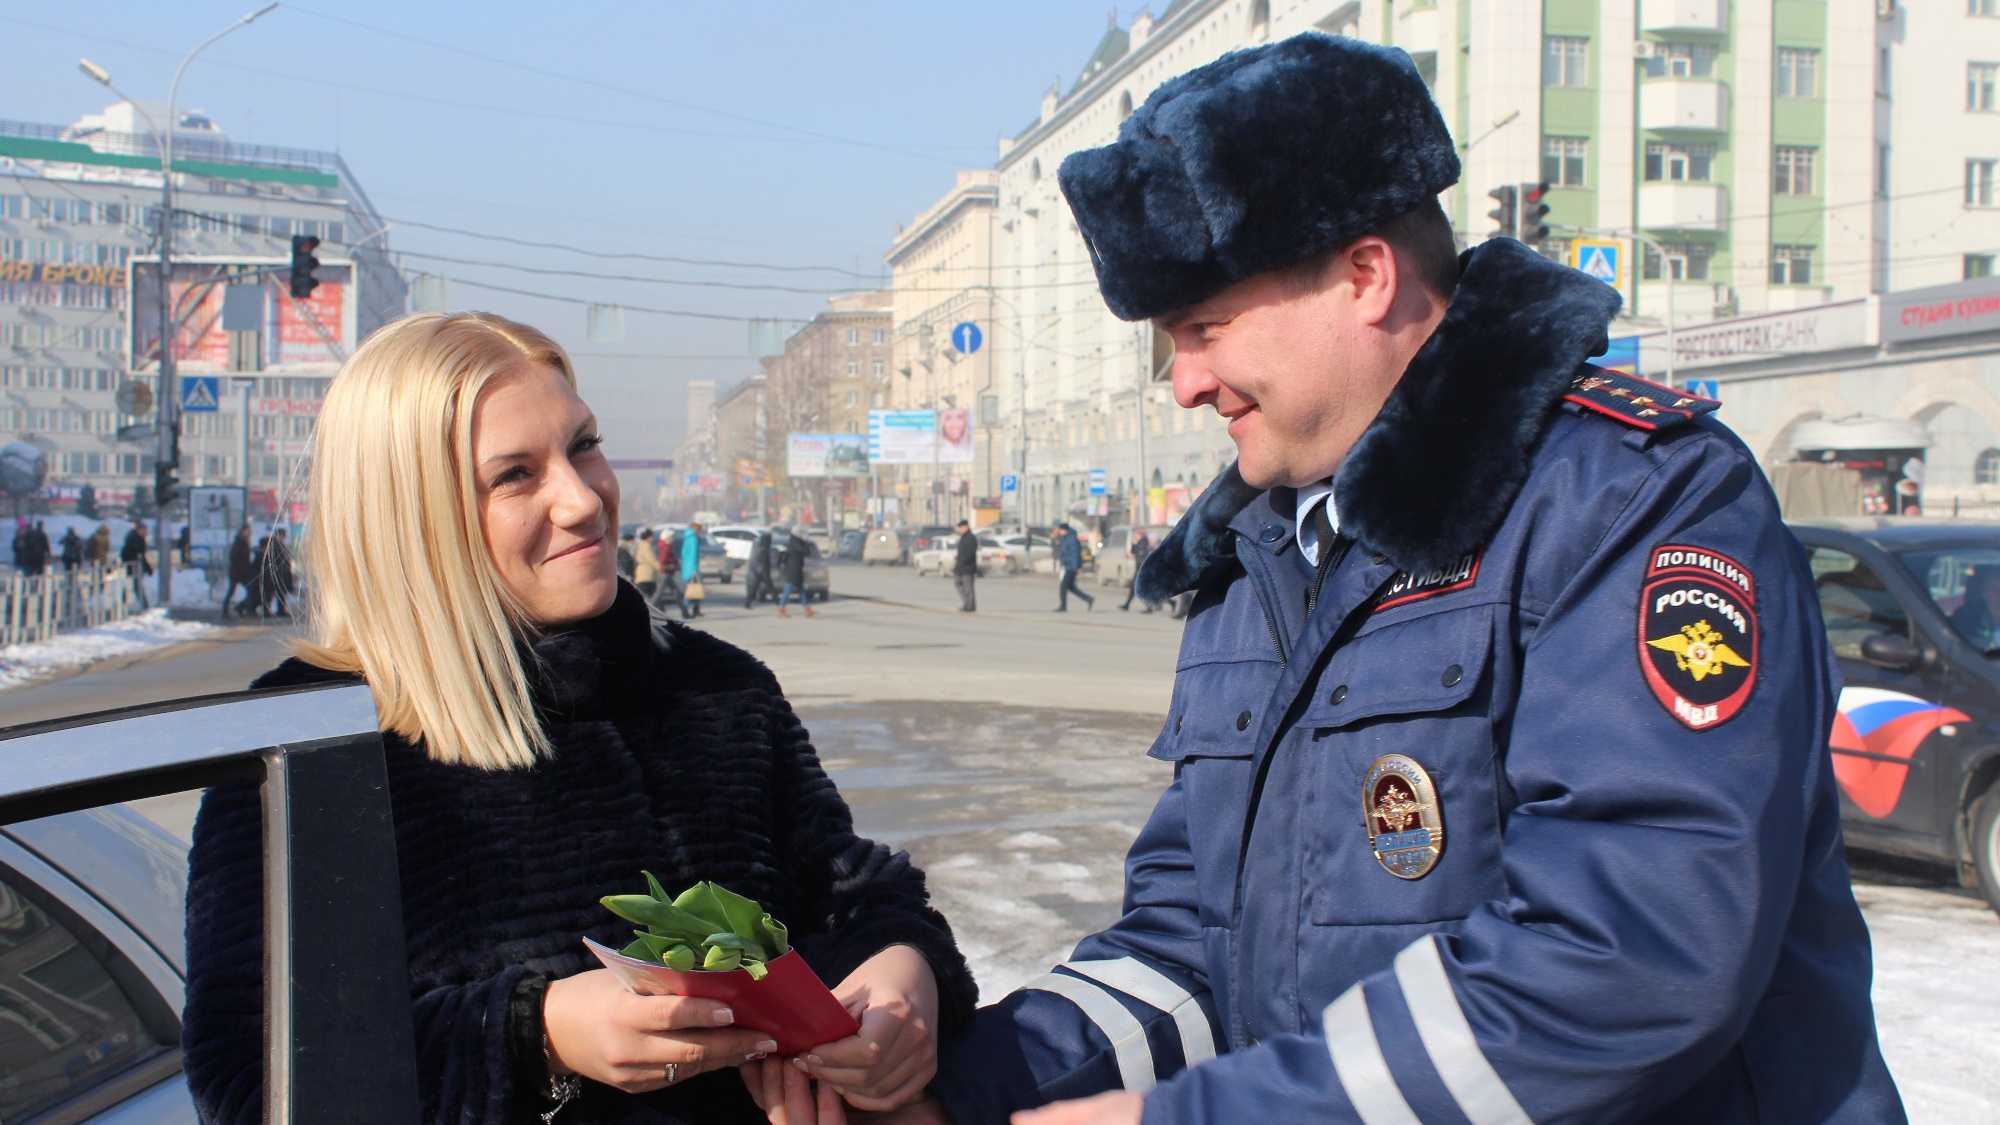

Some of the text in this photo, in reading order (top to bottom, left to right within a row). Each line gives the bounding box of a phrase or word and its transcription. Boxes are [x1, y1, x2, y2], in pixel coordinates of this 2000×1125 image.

[1902, 300, 1954, 328] СТУДИЯ
[1656, 552, 1749, 592] ПОЛИЦИЯ
[1656, 589, 1746, 634] РОССИЯ
[1675, 696, 1718, 726] МВД
